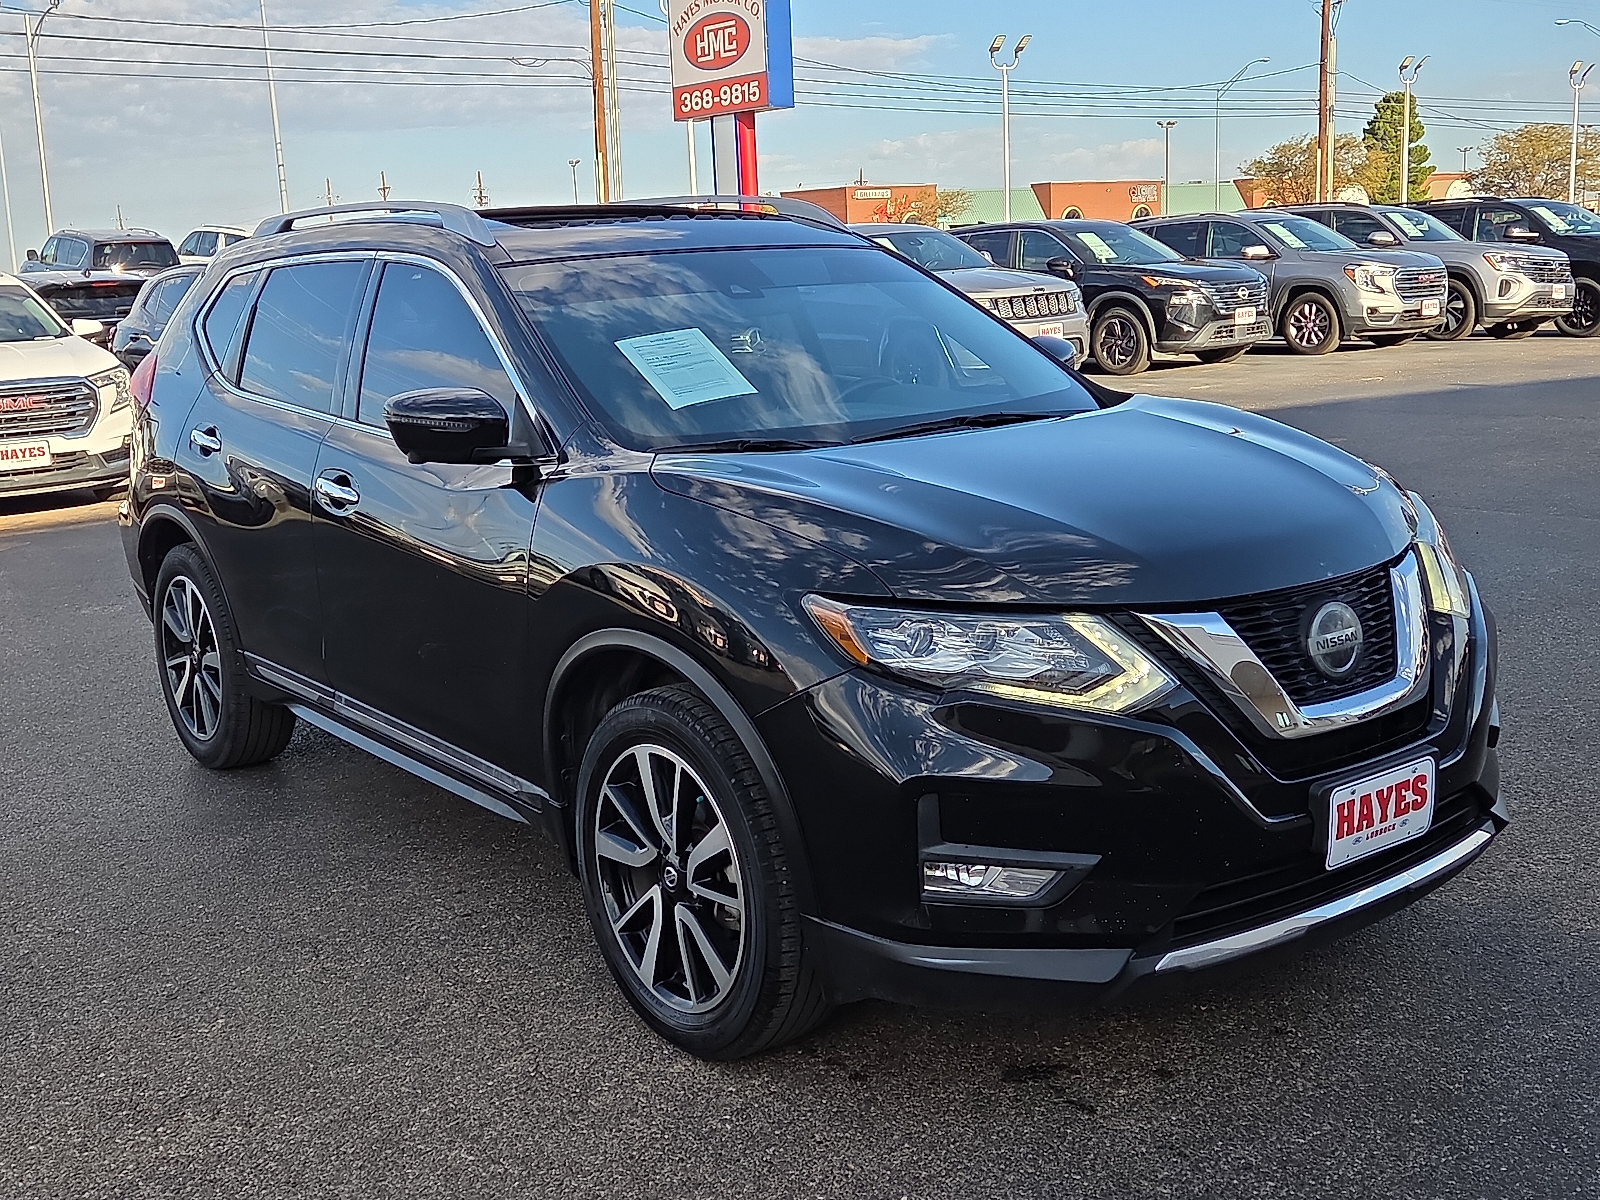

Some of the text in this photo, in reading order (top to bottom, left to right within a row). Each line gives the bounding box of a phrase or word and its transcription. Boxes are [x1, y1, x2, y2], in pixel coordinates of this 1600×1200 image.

[672, 0, 760, 37] HAYES CO.
[695, 19, 738, 63] HMC
[680, 80, 760, 113] 368-9815
[1041, 326, 1062, 336] HAYES
[0, 446, 46, 461] HAYES
[1315, 629, 1358, 651] NISSAN
[1335, 774, 1428, 841] HAYES
